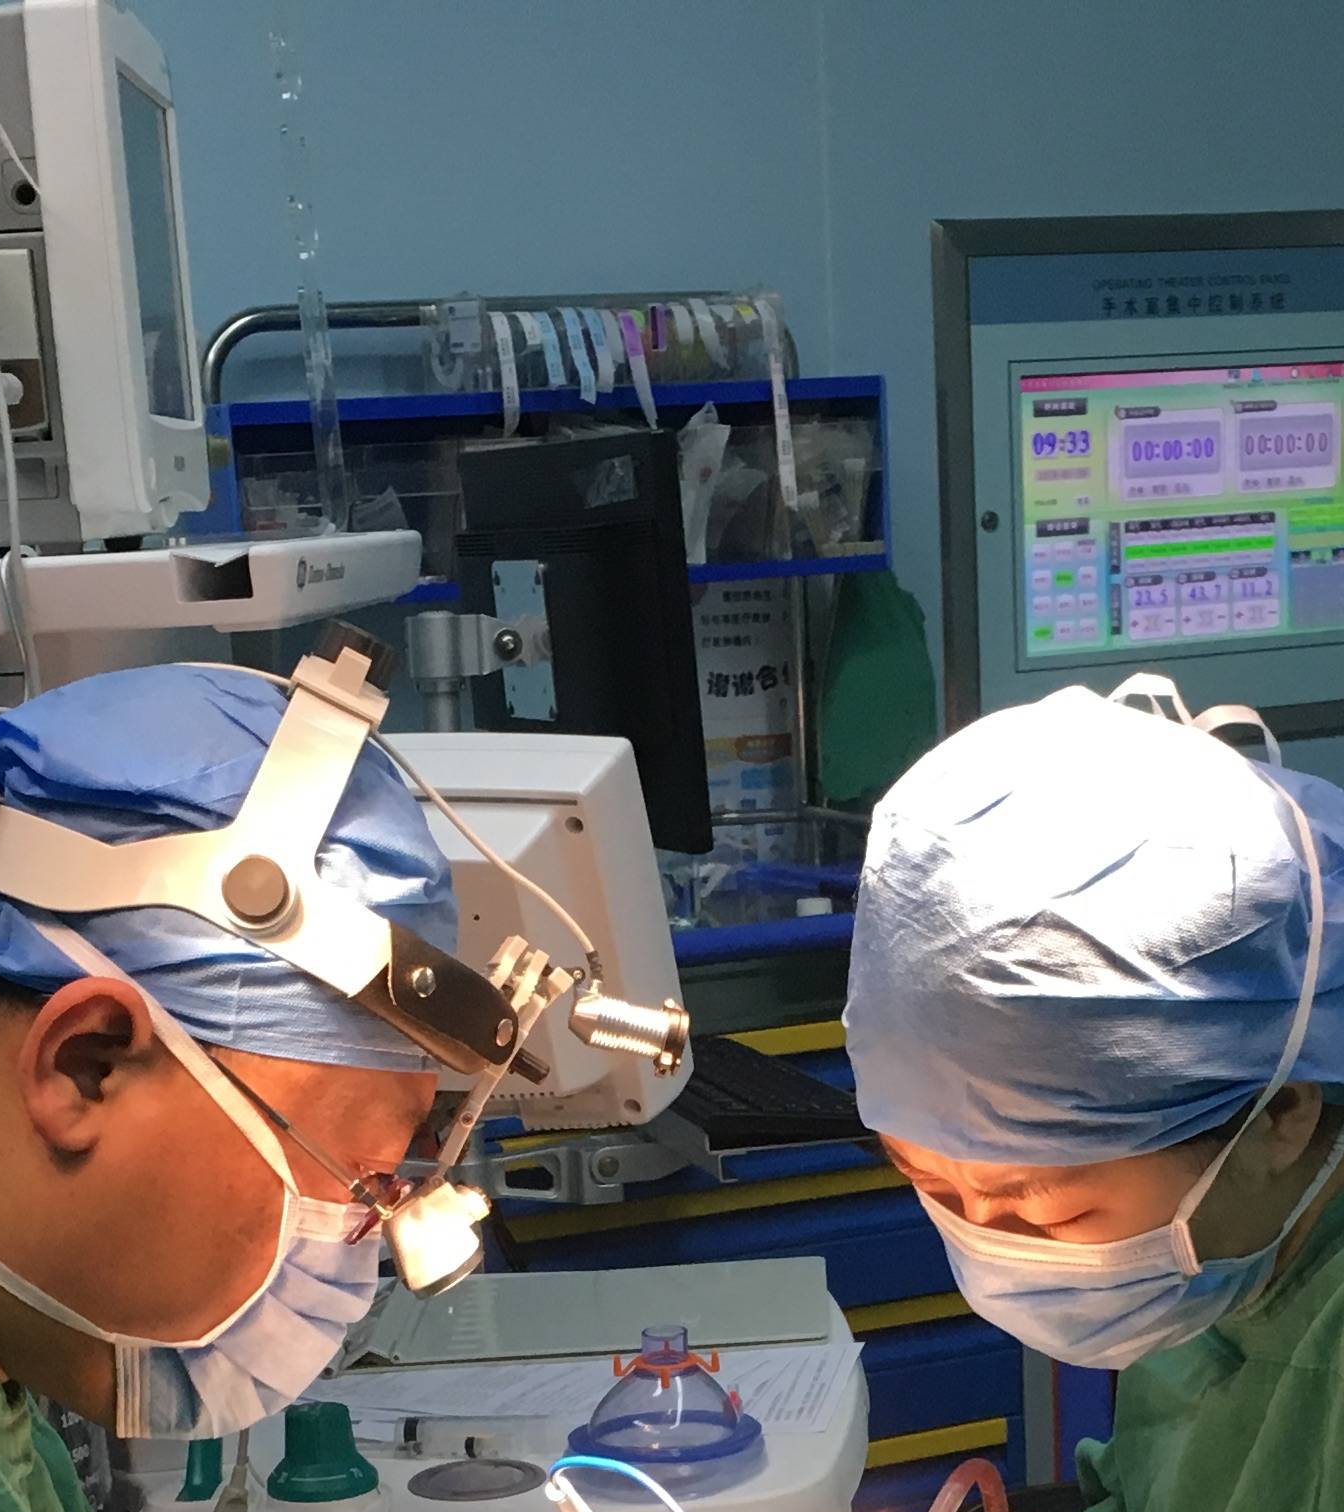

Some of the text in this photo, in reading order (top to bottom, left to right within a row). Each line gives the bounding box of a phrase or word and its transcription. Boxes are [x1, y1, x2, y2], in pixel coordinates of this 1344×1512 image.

[1032, 430, 1090, 456] 09:33
[1132, 437, 1214, 461] 00:00:00
[1246, 432, 1328, 456] 00:00:00
